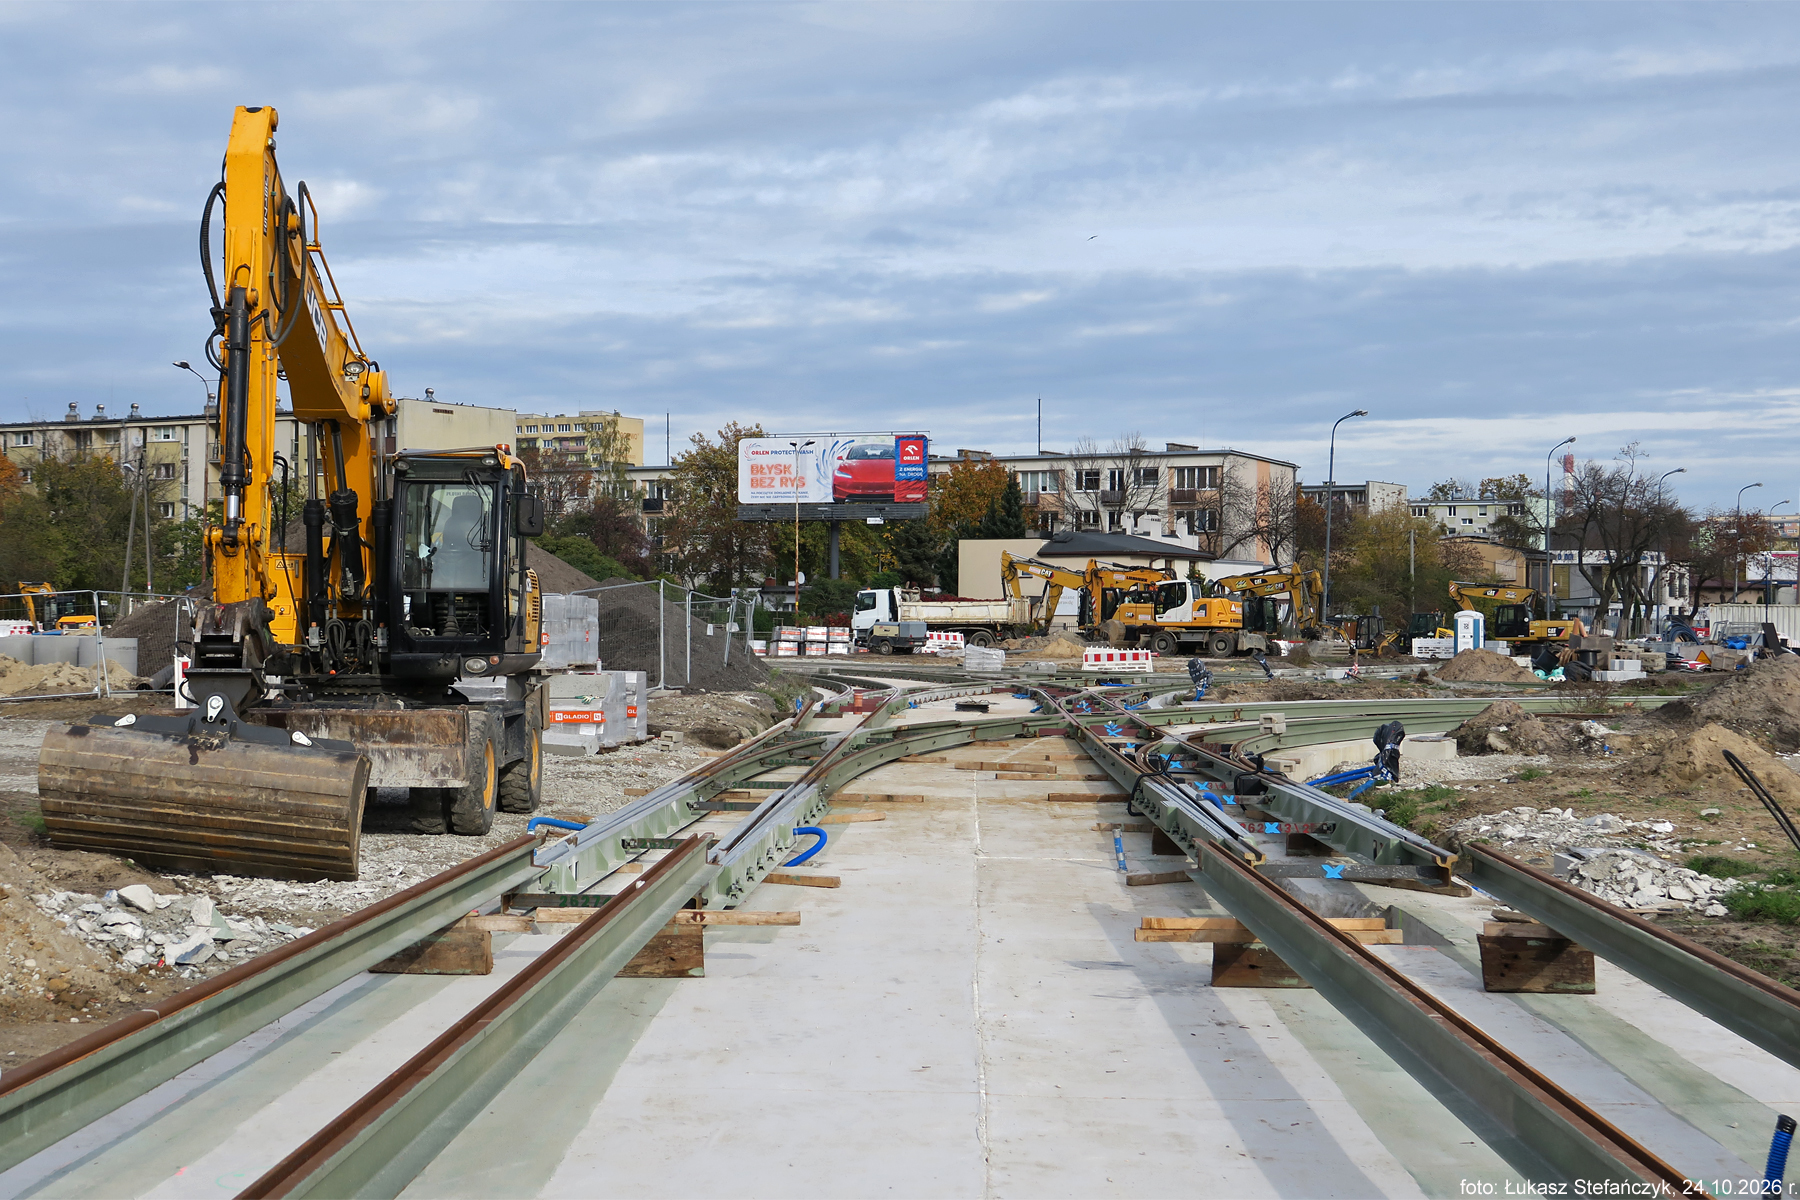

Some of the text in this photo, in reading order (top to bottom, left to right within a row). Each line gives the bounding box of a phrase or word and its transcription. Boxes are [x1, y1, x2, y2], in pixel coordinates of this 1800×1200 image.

[306, 289, 328, 355] JCB
[750, 463, 793, 476] BŁYSK
[750, 475, 806, 489] BEZ RYS
[1041, 568, 1052, 577] CAT
